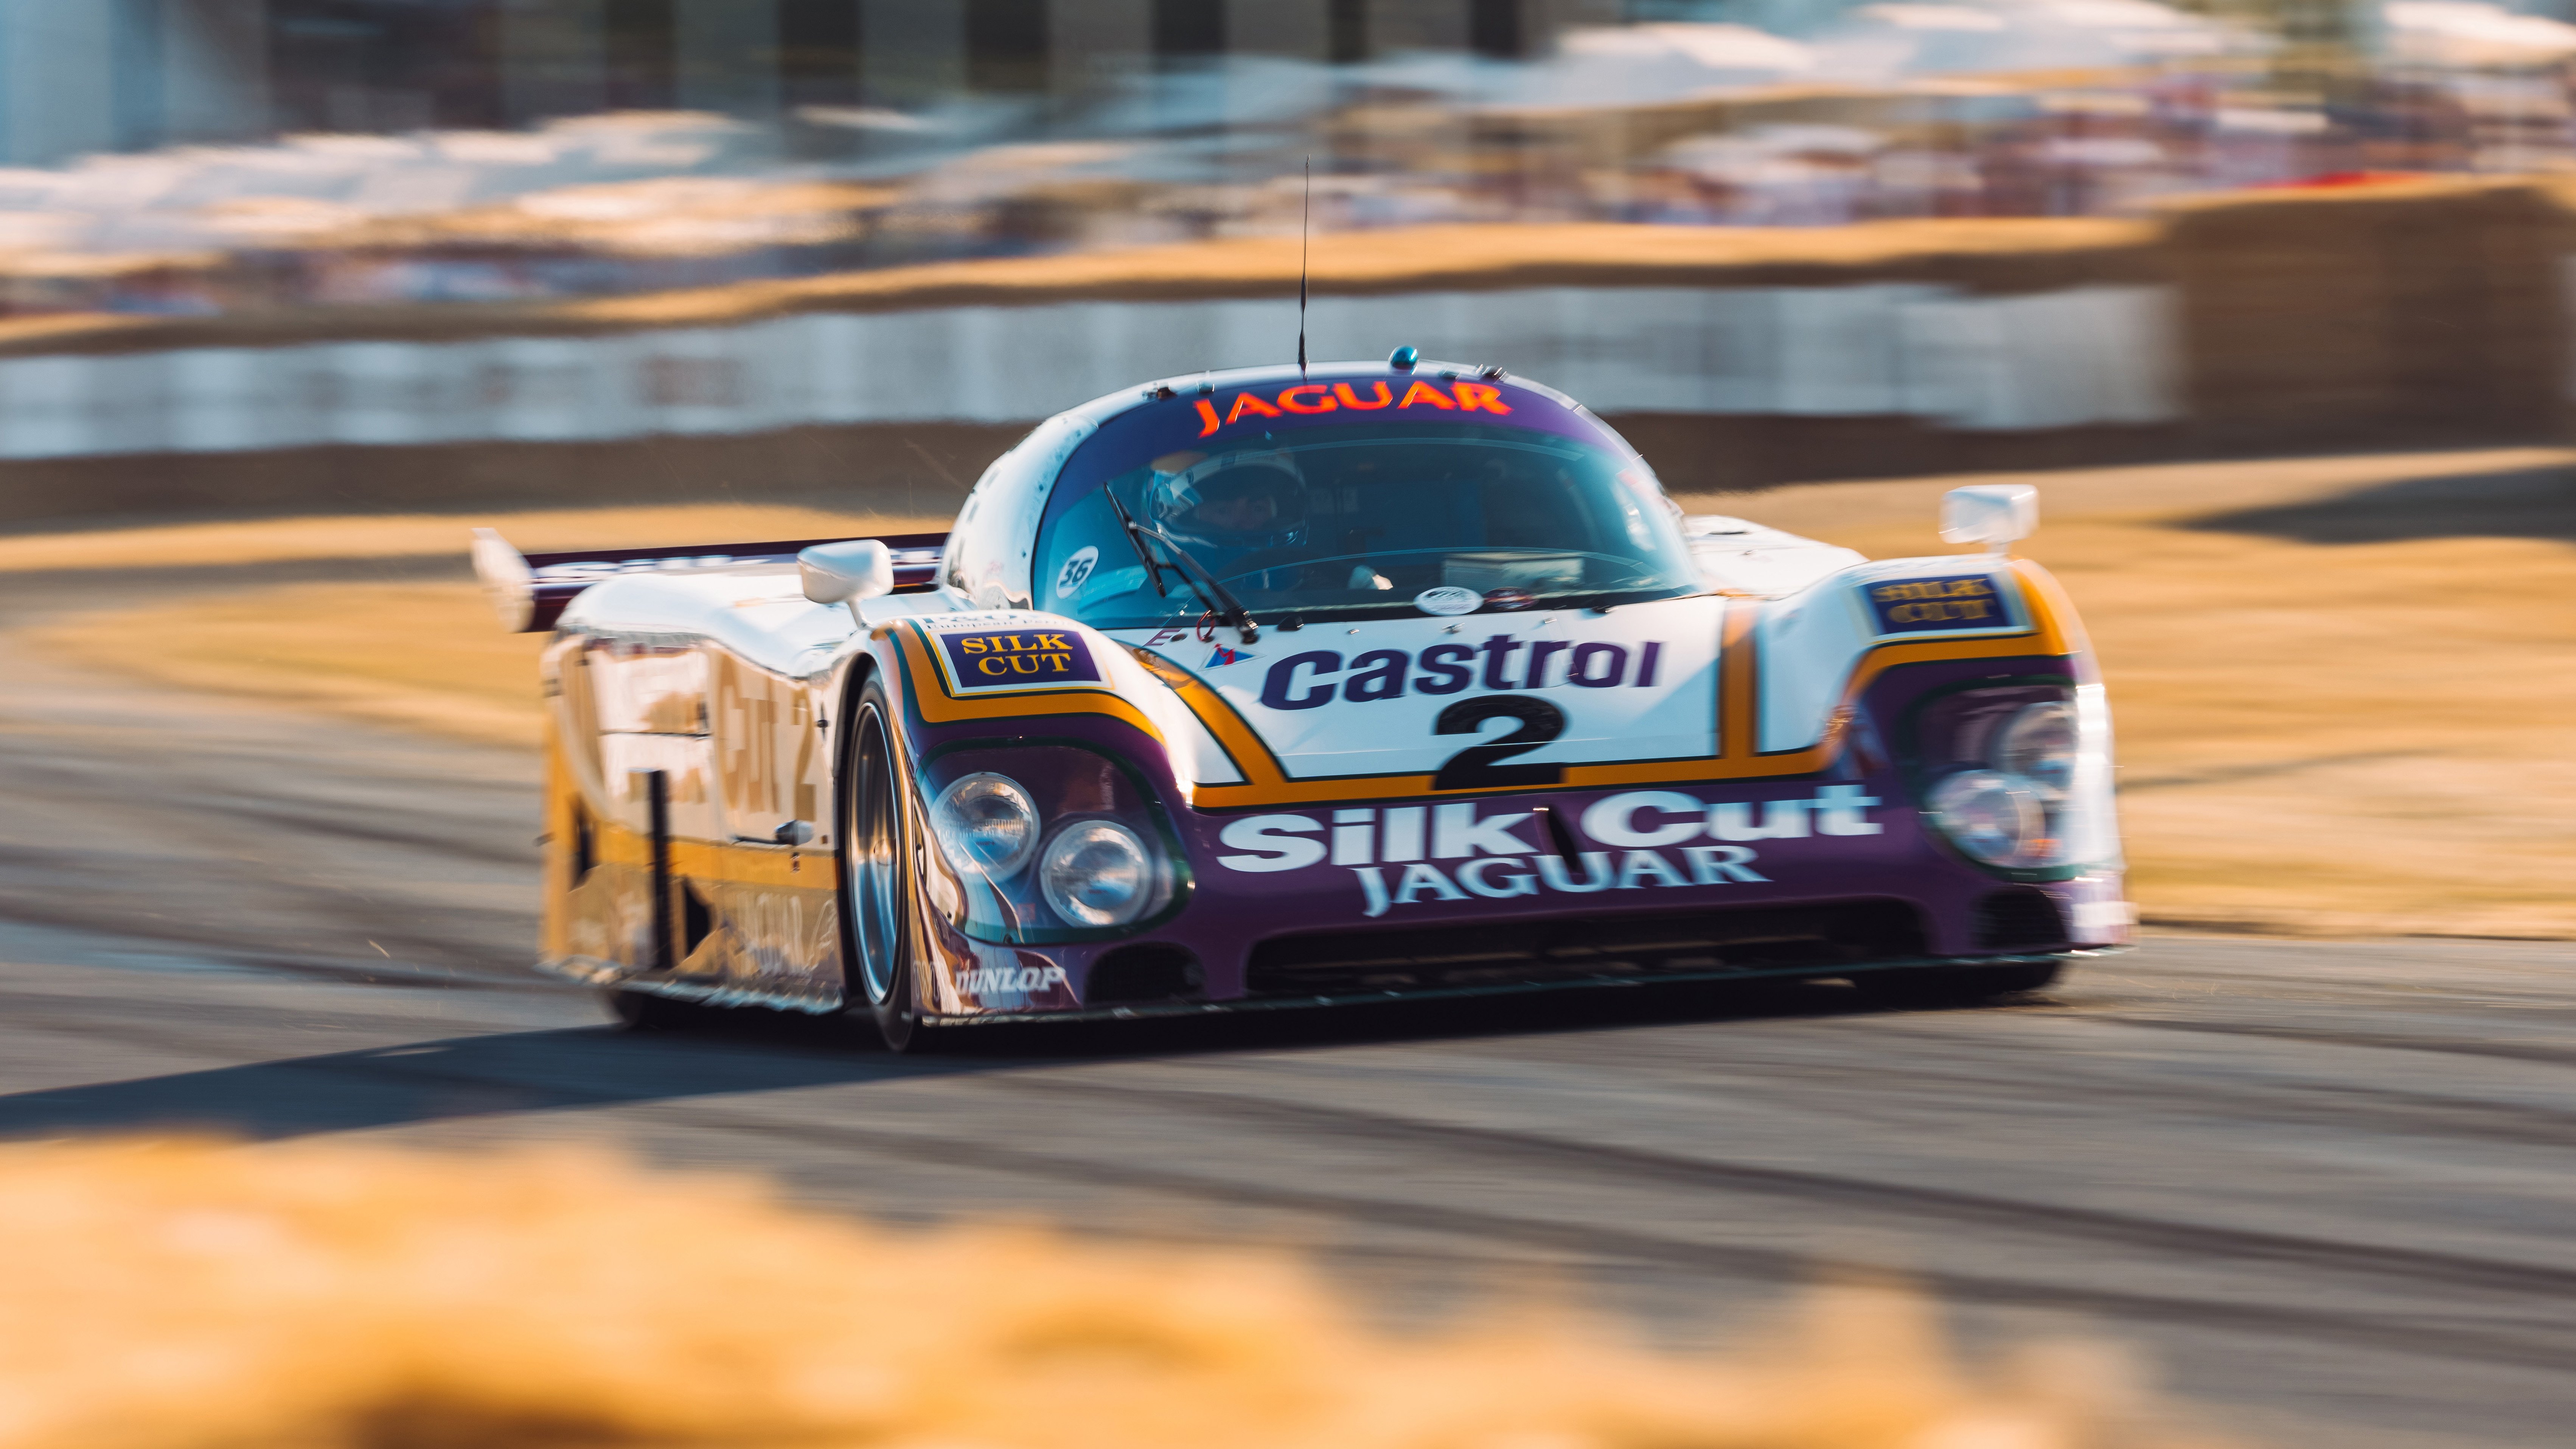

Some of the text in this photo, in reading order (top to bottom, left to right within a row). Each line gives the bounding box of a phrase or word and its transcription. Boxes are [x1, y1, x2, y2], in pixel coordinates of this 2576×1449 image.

[1193, 380, 1514, 438] JAGUAR
[1059, 558, 1093, 587] 36
[961, 634, 1073, 654] SILK
[978, 653, 1071, 676] CUT
[1142, 628, 1182, 647] E
[1260, 634, 1668, 711] Castrol
[791, 686, 817, 822] 2
[1430, 694, 1571, 791] 2
[1217, 785, 1884, 873] Silk Cut
[1349, 845, 1774, 918] JAGUAR
[956, 966, 1066, 996] DUNLOP
